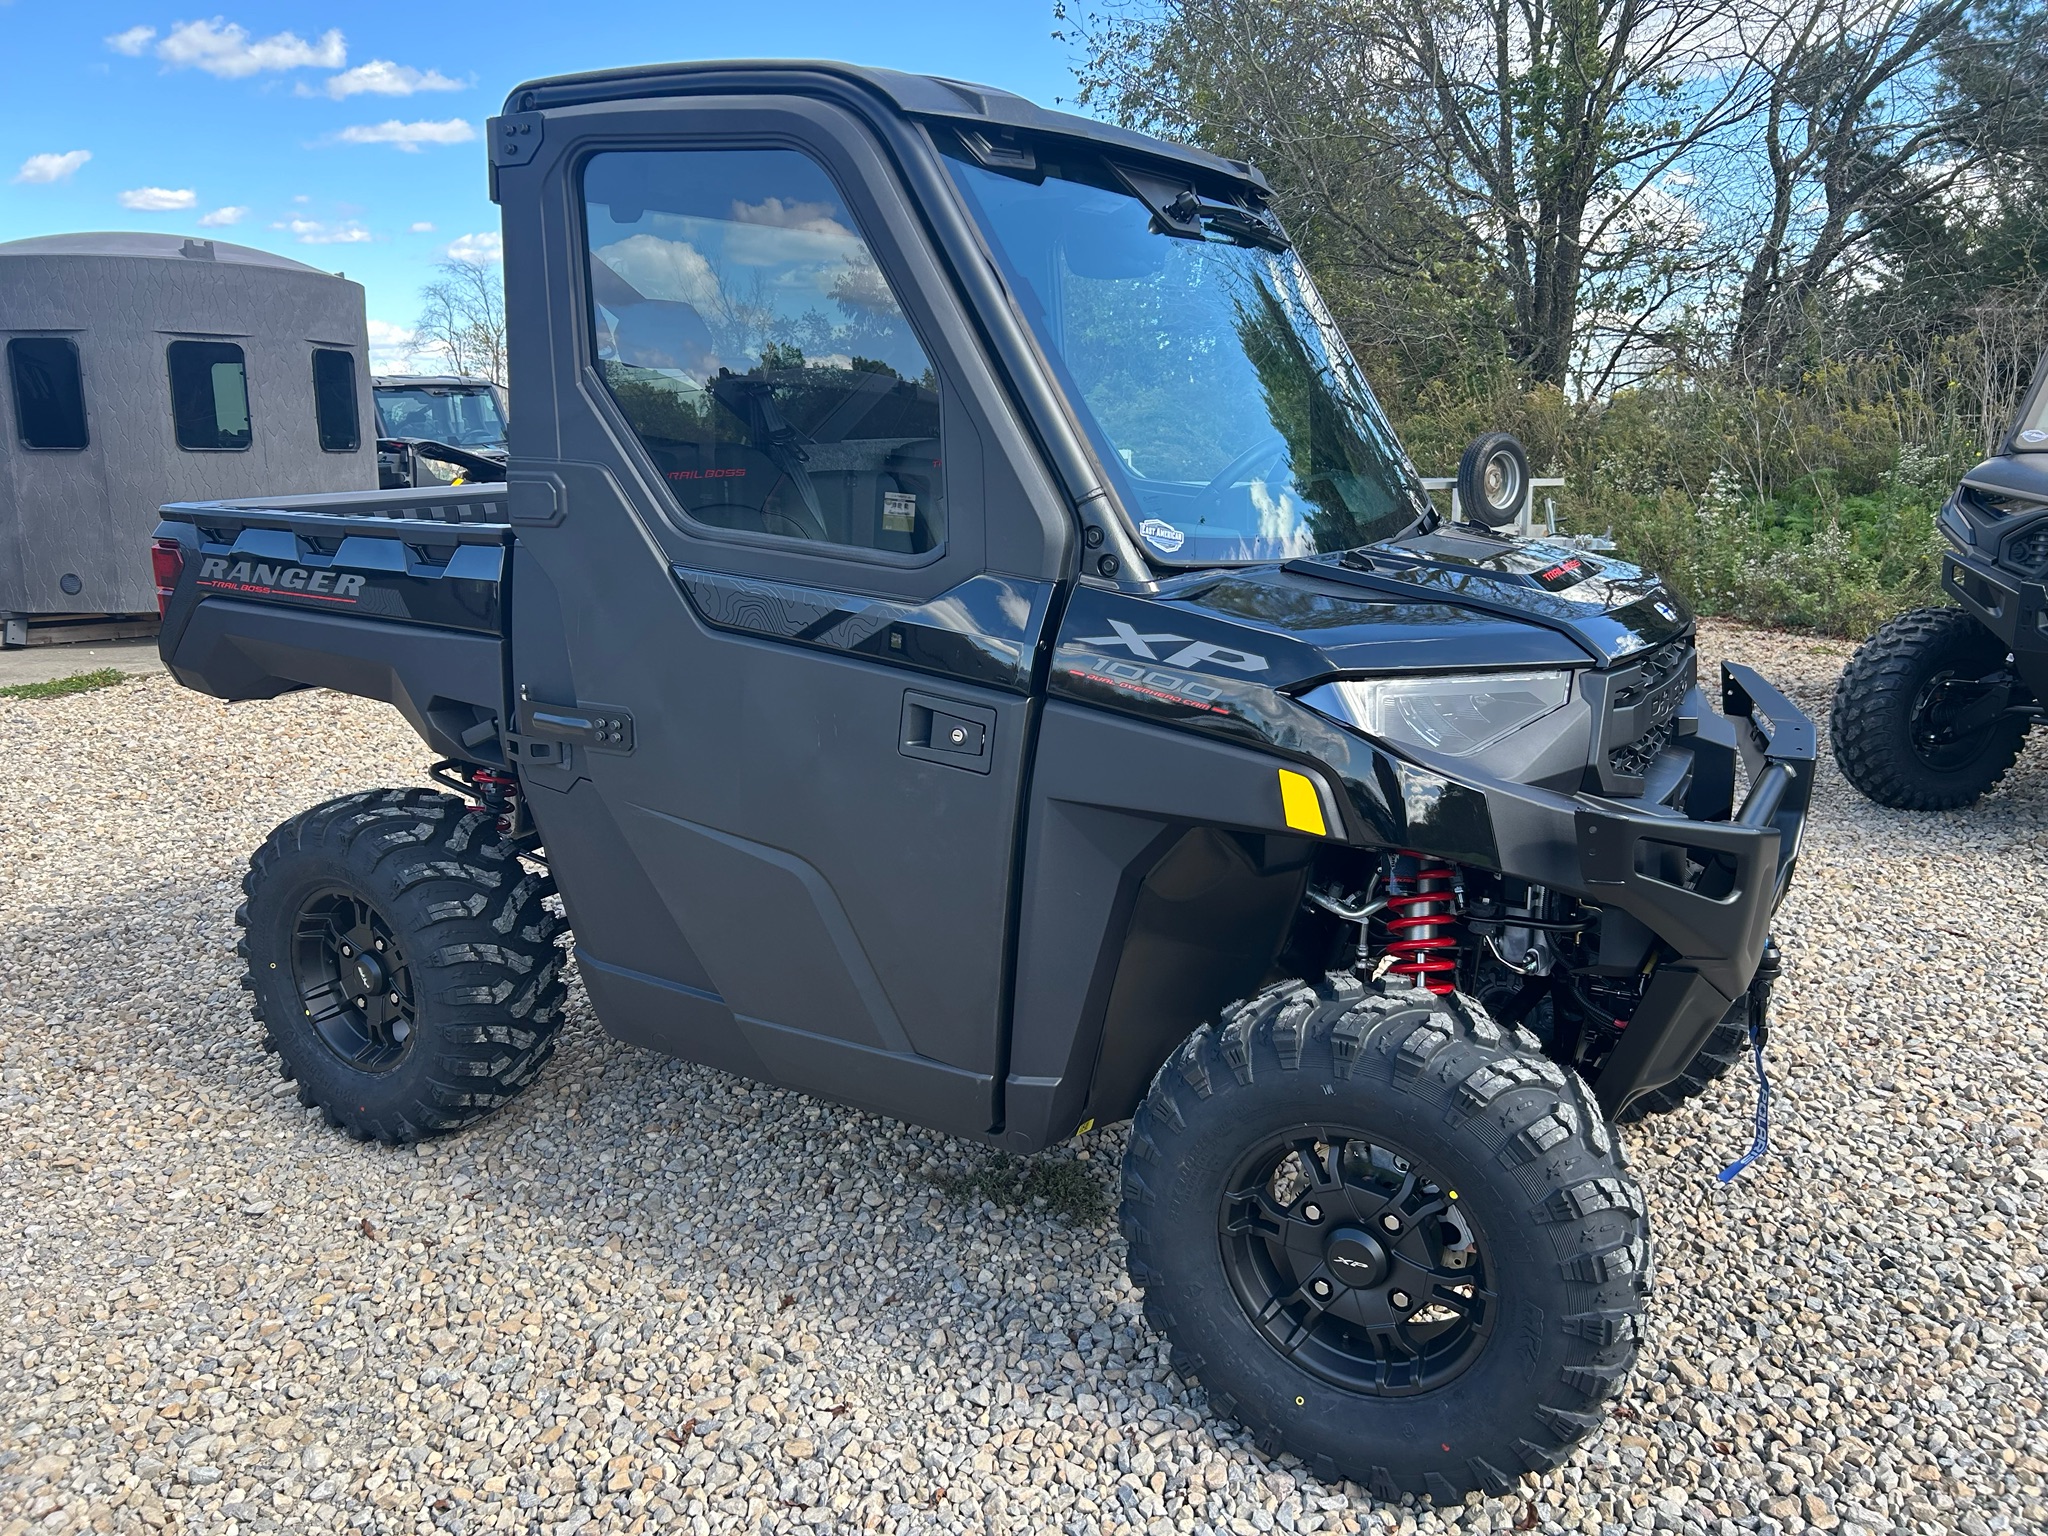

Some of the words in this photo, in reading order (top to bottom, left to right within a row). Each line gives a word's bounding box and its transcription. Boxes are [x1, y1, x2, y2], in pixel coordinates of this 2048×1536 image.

[704, 469, 746, 478] BOSS
[199, 558, 366, 597] RANGER
[211, 580, 239, 590] TRAIL
[240, 584, 271, 594] BOSS
[1072, 618, 1269, 672] XP
[1086, 674, 1116, 686] DUAL
[1119, 681, 1182, 703] OVERHEAD
[1182, 698, 1212, 711] CAM
[1091, 658, 1223, 701] 1000
[1740, 1088, 1768, 1165] POLARIS
[1333, 1256, 1369, 1268] XP
